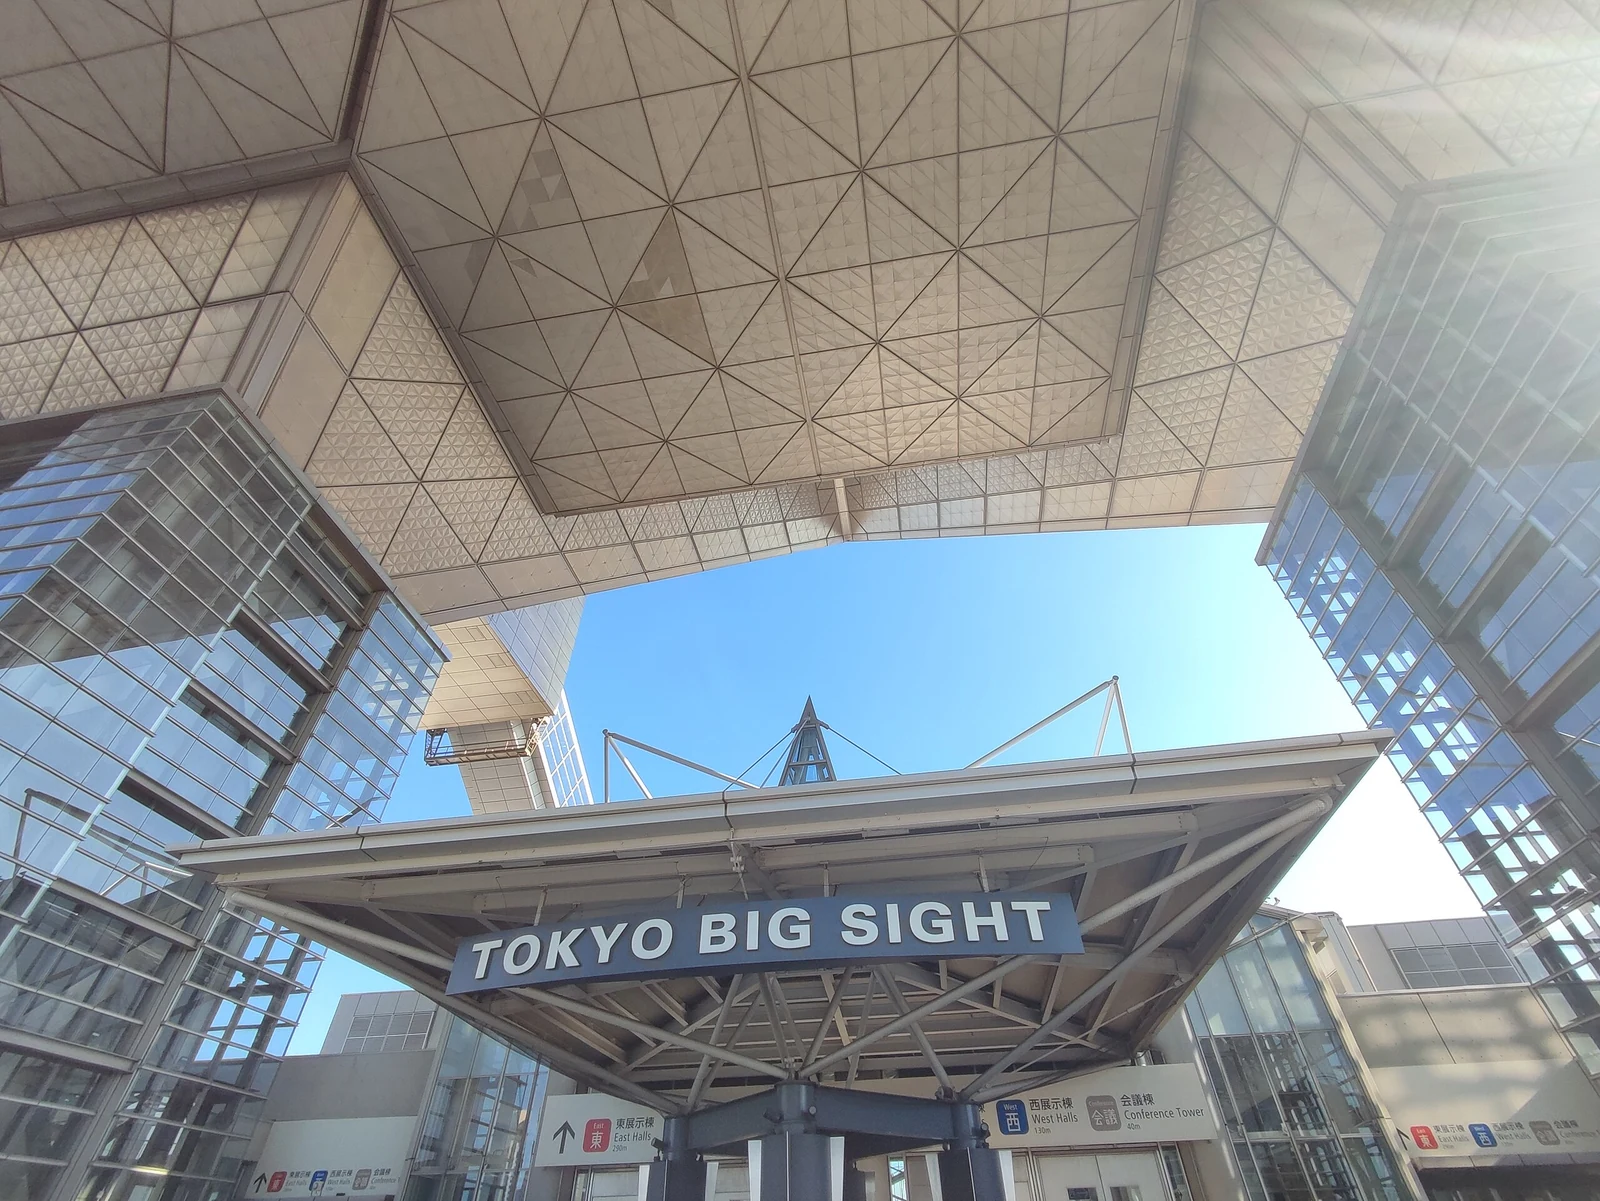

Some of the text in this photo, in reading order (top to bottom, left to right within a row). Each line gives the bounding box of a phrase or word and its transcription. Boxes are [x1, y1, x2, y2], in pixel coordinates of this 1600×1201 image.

[471, 901, 1052, 980] TOKYO BIG SIGHT
[1028, 1097, 1074, 1111] 西展示棟
[1120, 1093, 1156, 1107] 会議棟
[1003, 1103, 1018, 1111] West
[1124, 1107, 1204, 1120] Conference Tower
[615, 1117, 655, 1130] 東展示棟
[1005, 1112, 1021, 1132] 西
[1031, 1111, 1079, 1124] West Halls
[1091, 1108, 1118, 1126] 会議
[1127, 1122, 1141, 1130] 40m
[1432, 1124, 1466, 1133] 東展示棟
[590, 1131, 604, 1149] 東
[614, 1131, 651, 1142] East Halls
[1418, 1134, 1433, 1148] 東
[1437, 1135, 1452, 1143] East
[1477, 1132, 1492, 1146] 西
[1496, 1132, 1514, 1140] West
[612, 1144, 628, 1152] 290m
